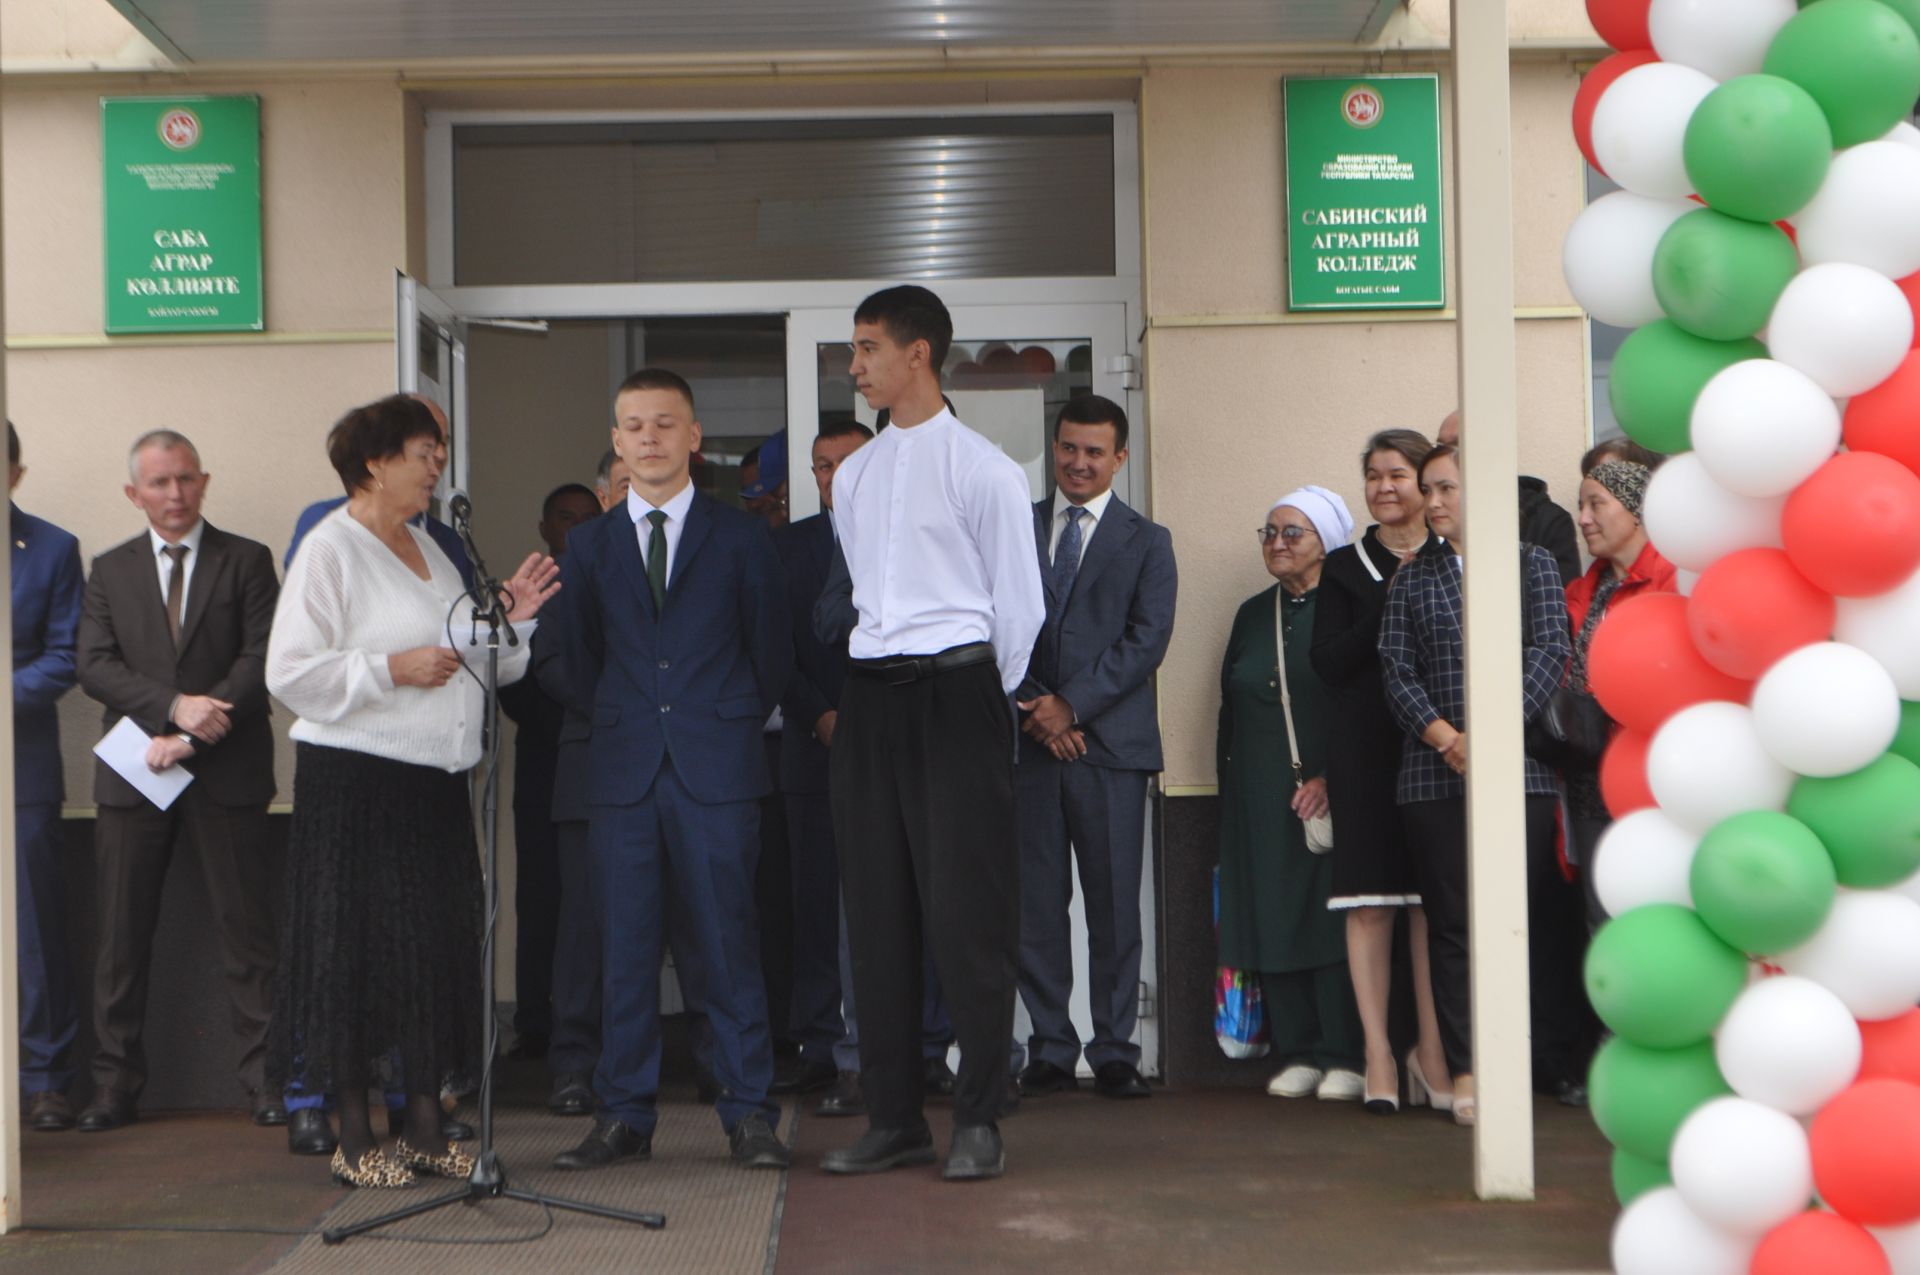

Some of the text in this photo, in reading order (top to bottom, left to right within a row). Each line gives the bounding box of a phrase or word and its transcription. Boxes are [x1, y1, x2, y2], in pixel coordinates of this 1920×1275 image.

[1302, 202, 1428, 226] САБИНСКИЙ
[153, 229, 209, 249] САБА
[1311, 227, 1420, 249] АГРАРНЫЙ
[150, 253, 214, 272] АГРАР
[1316, 254, 1418, 274] КОЛЛЕДЖ
[1336, 284, 1400, 295] БОГАТЫЕ САБЫ
